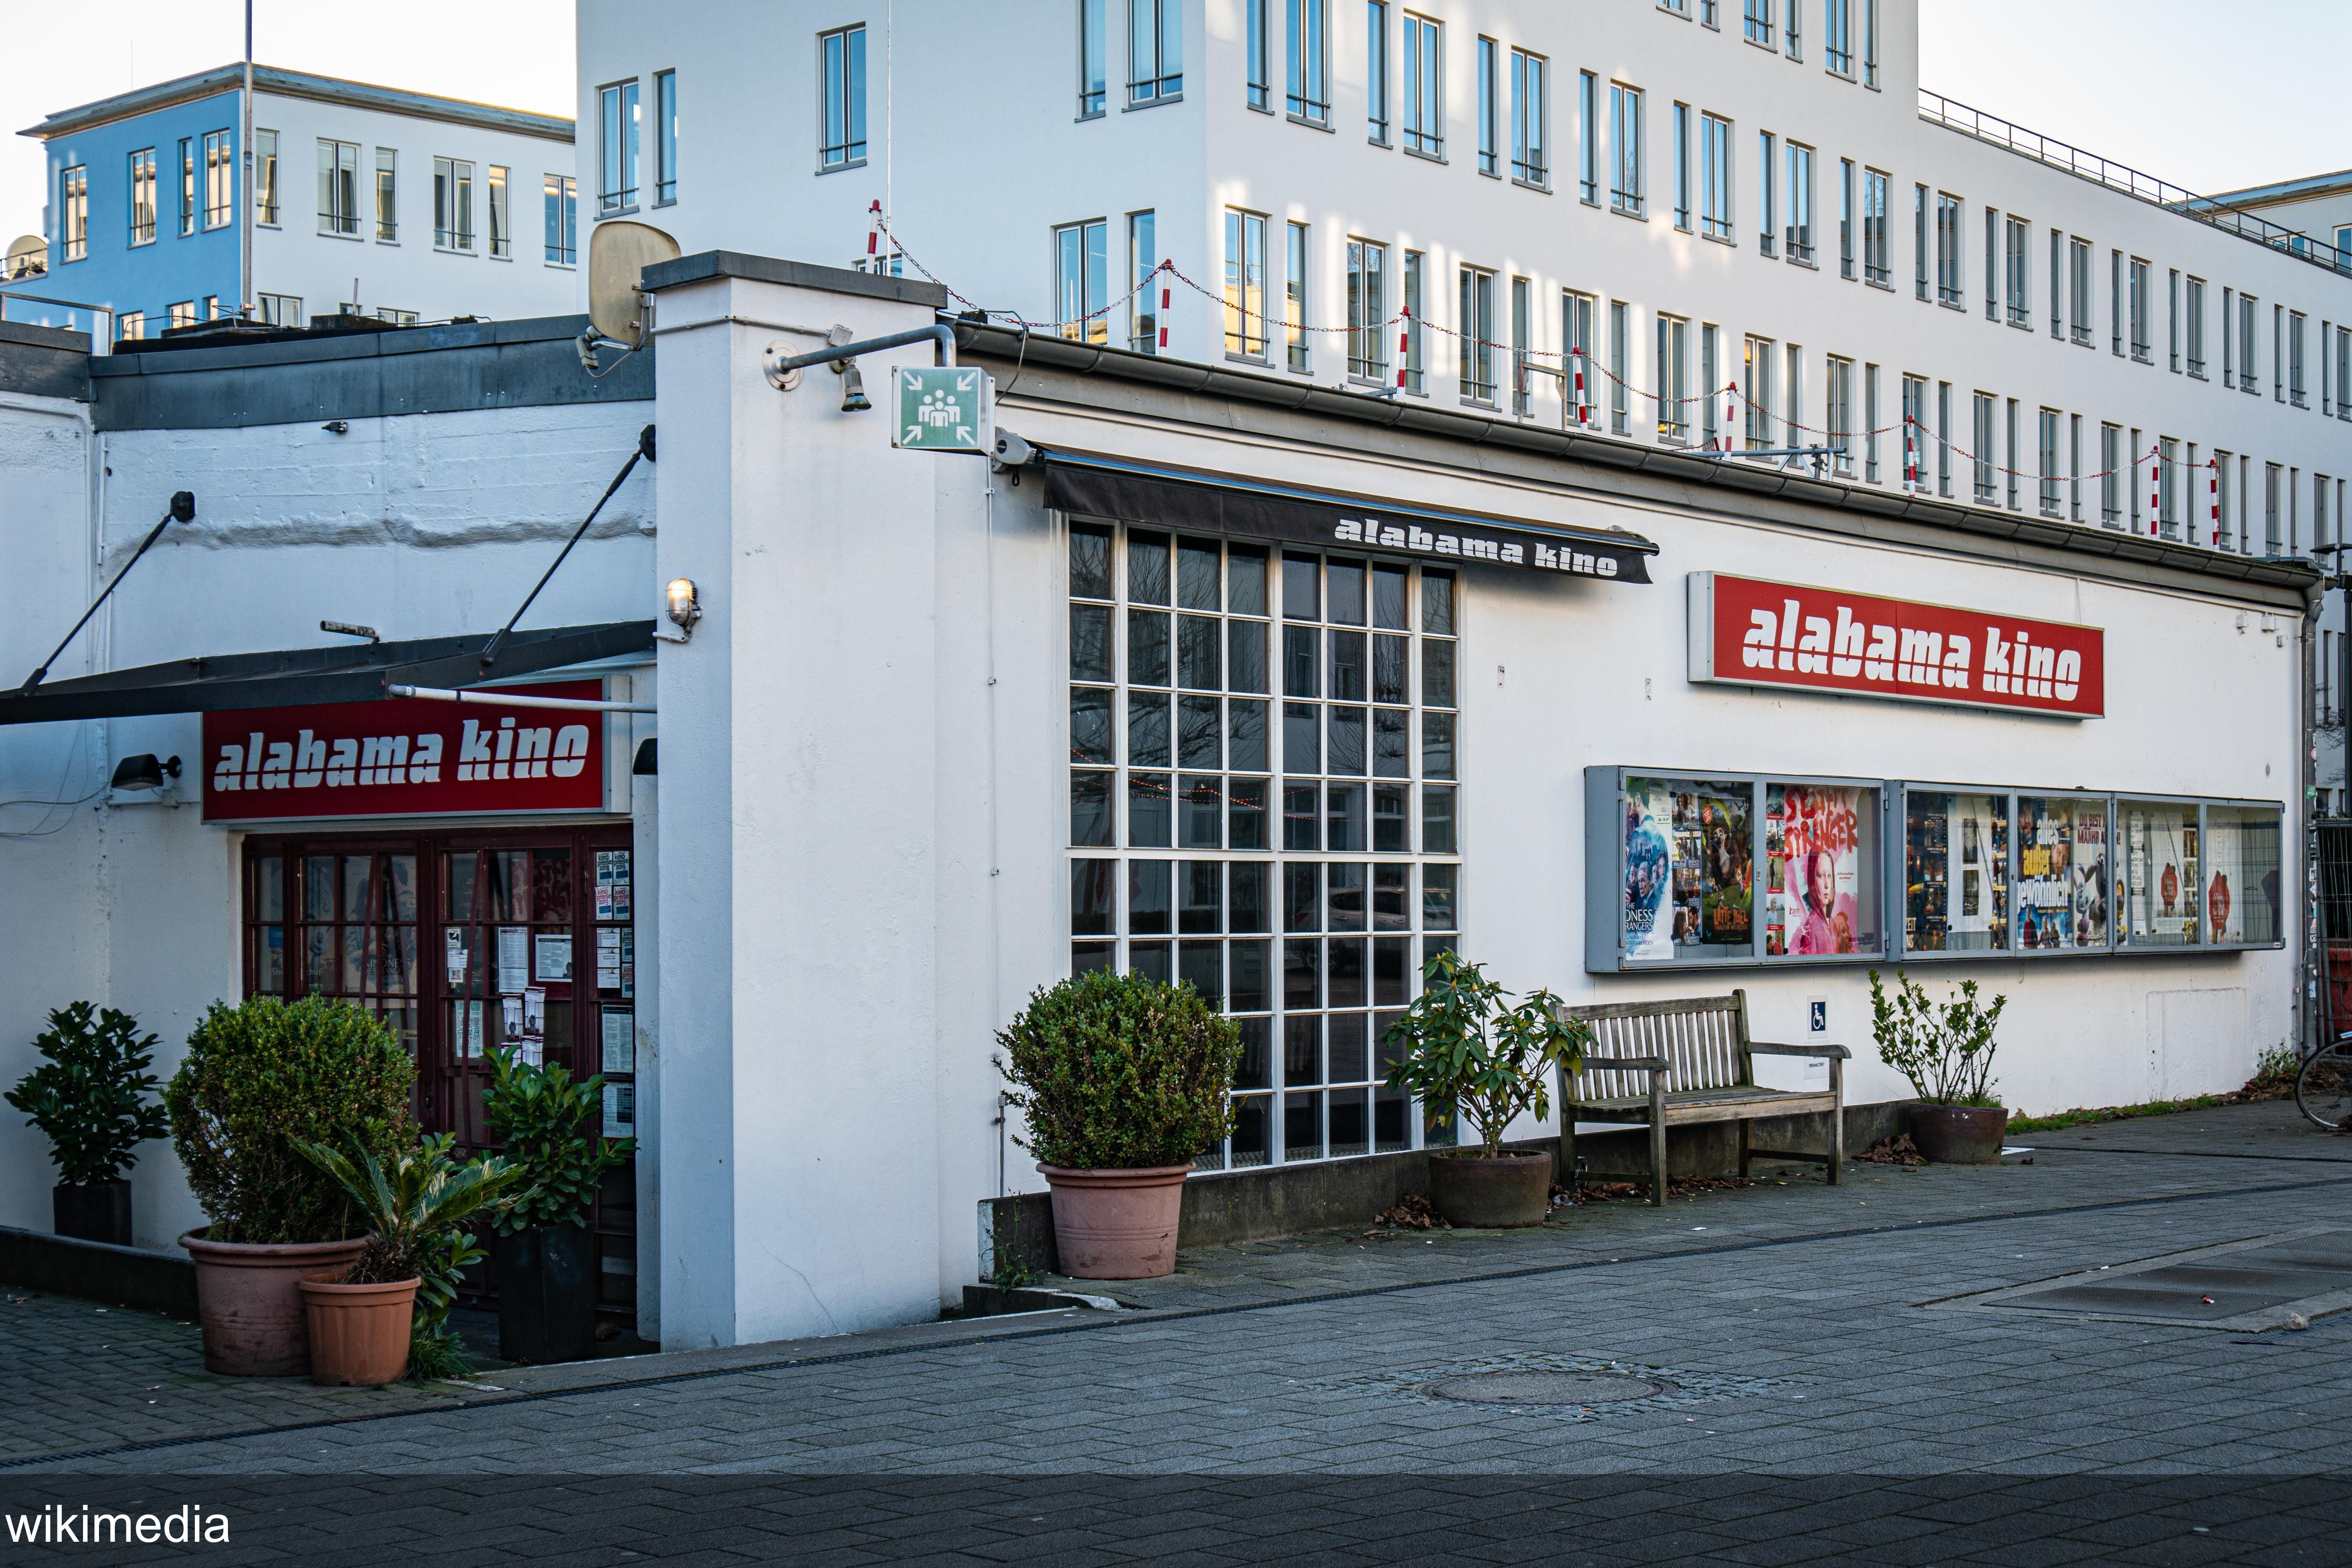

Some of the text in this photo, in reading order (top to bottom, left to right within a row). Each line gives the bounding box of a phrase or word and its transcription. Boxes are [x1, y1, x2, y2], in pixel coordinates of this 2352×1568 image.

[1335, 518, 1617, 576] alabama kino
[1742, 599, 2081, 701] alabama kino
[214, 717, 589, 792] alabama kino
[2037, 812, 2059, 845] alles
[2023, 844, 2050, 875] außer
[597, 893, 611, 902] preise
[614, 894, 629, 902] preise
